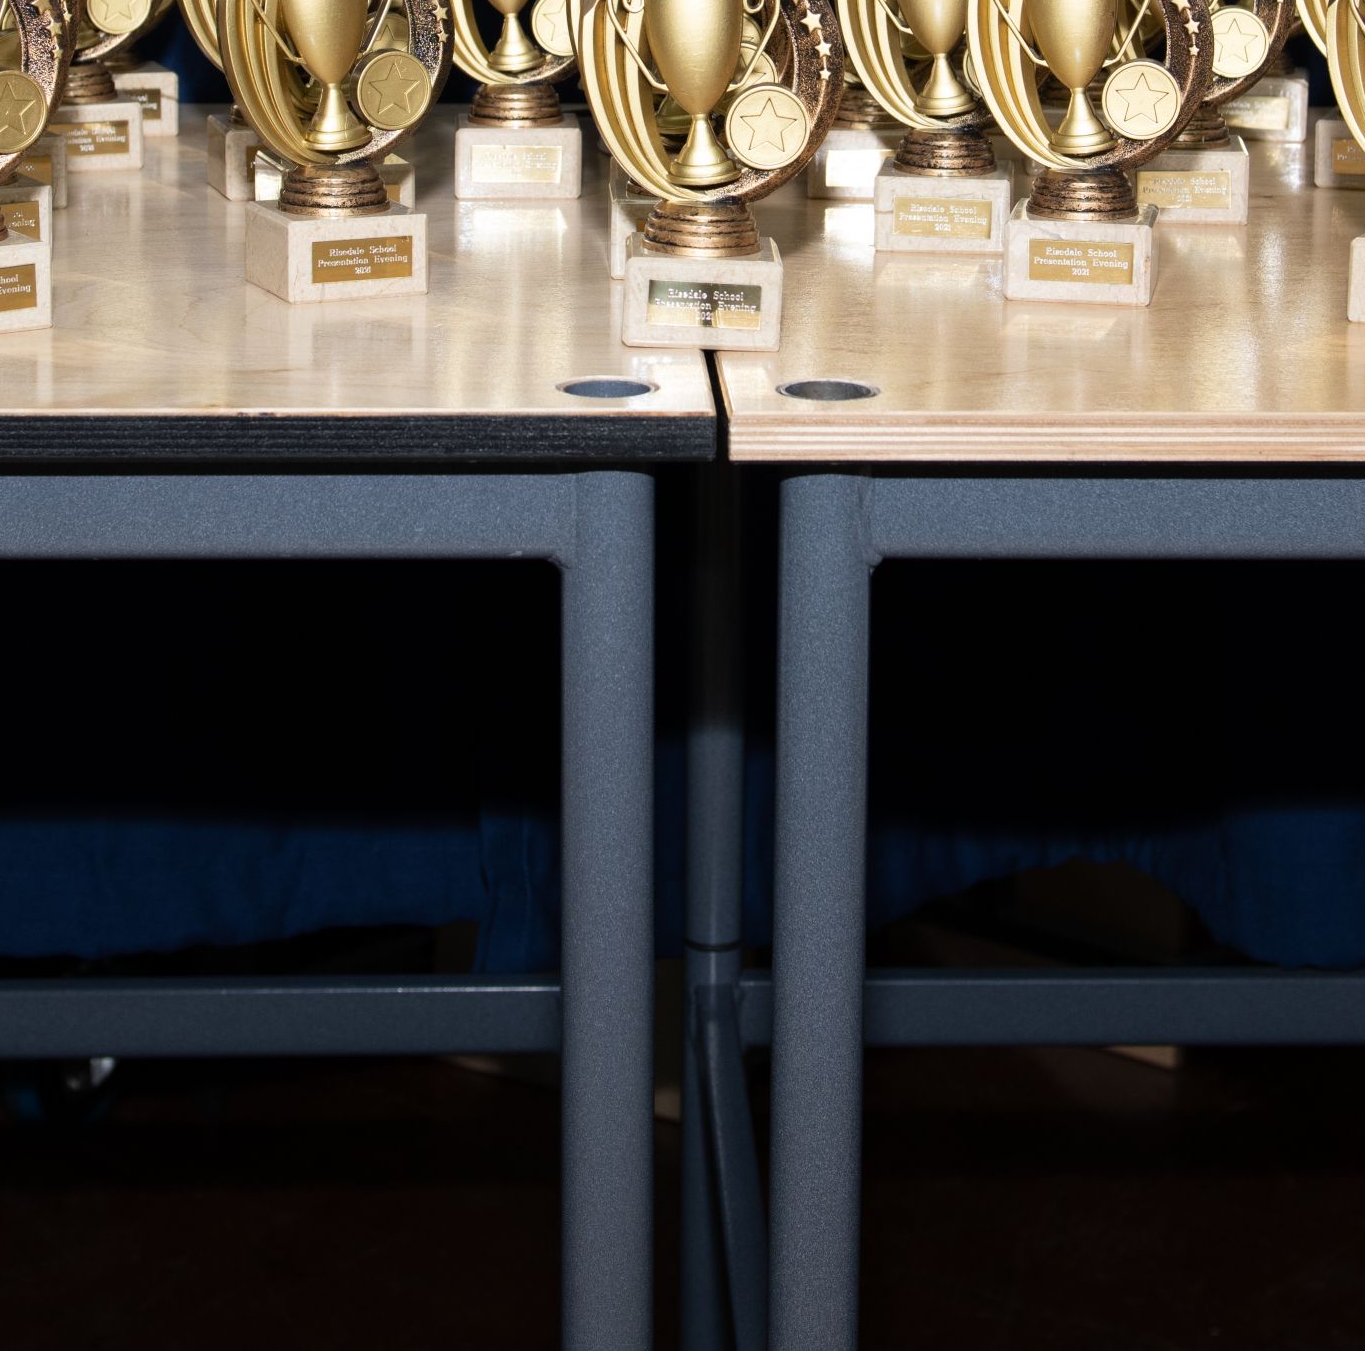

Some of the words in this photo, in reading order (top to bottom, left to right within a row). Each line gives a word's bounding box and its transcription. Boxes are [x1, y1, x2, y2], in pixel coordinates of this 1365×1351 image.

[910, 203, 944, 212] Risedale
[950, 206, 976, 214] School
[899, 212, 948, 222] Presentation
[954, 215, 987, 225] Evening
[329, 247, 364, 256] Risedale
[370, 245, 396, 254] School
[1046, 247, 1082, 256] Risedale
[1088, 249, 1116, 258] School
[318, 258, 368, 267] Presentation
[375, 255, 407, 263] Evening
[1034, 257, 1087, 266] Presentation
[1093, 259, 1128, 269] Evening
[668, 288, 707, 299] Risedale
[713, 291, 743, 301] School
[718, 301, 756, 313] Evening
